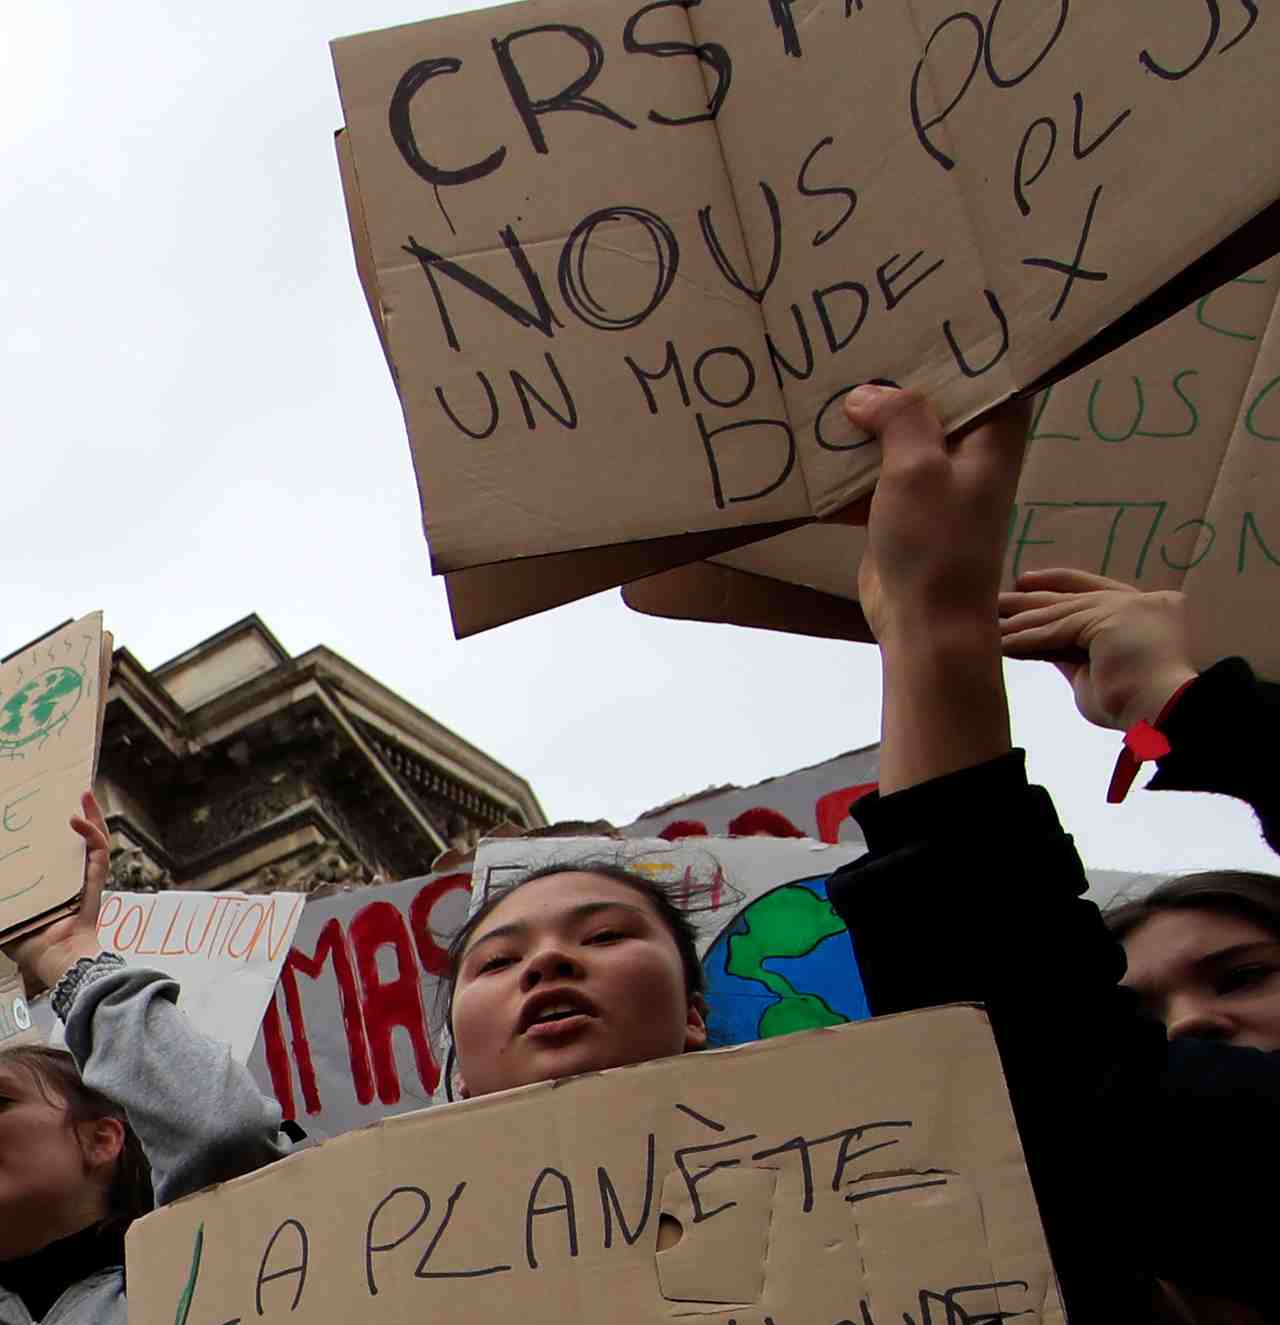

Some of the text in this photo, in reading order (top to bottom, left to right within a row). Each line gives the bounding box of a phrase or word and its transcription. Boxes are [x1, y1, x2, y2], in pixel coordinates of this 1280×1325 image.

[388, 0, 733, 186] CRS
[400, 137, 859, 353] NOUS
[435, 353, 579, 439] UN
[625, 249, 944, 415] MONDE
[697, 186, 1108, 509] DOUX
[96, 895, 303, 962] POLLUTION
[364, 1103, 950, 1297] PLANÈTE
